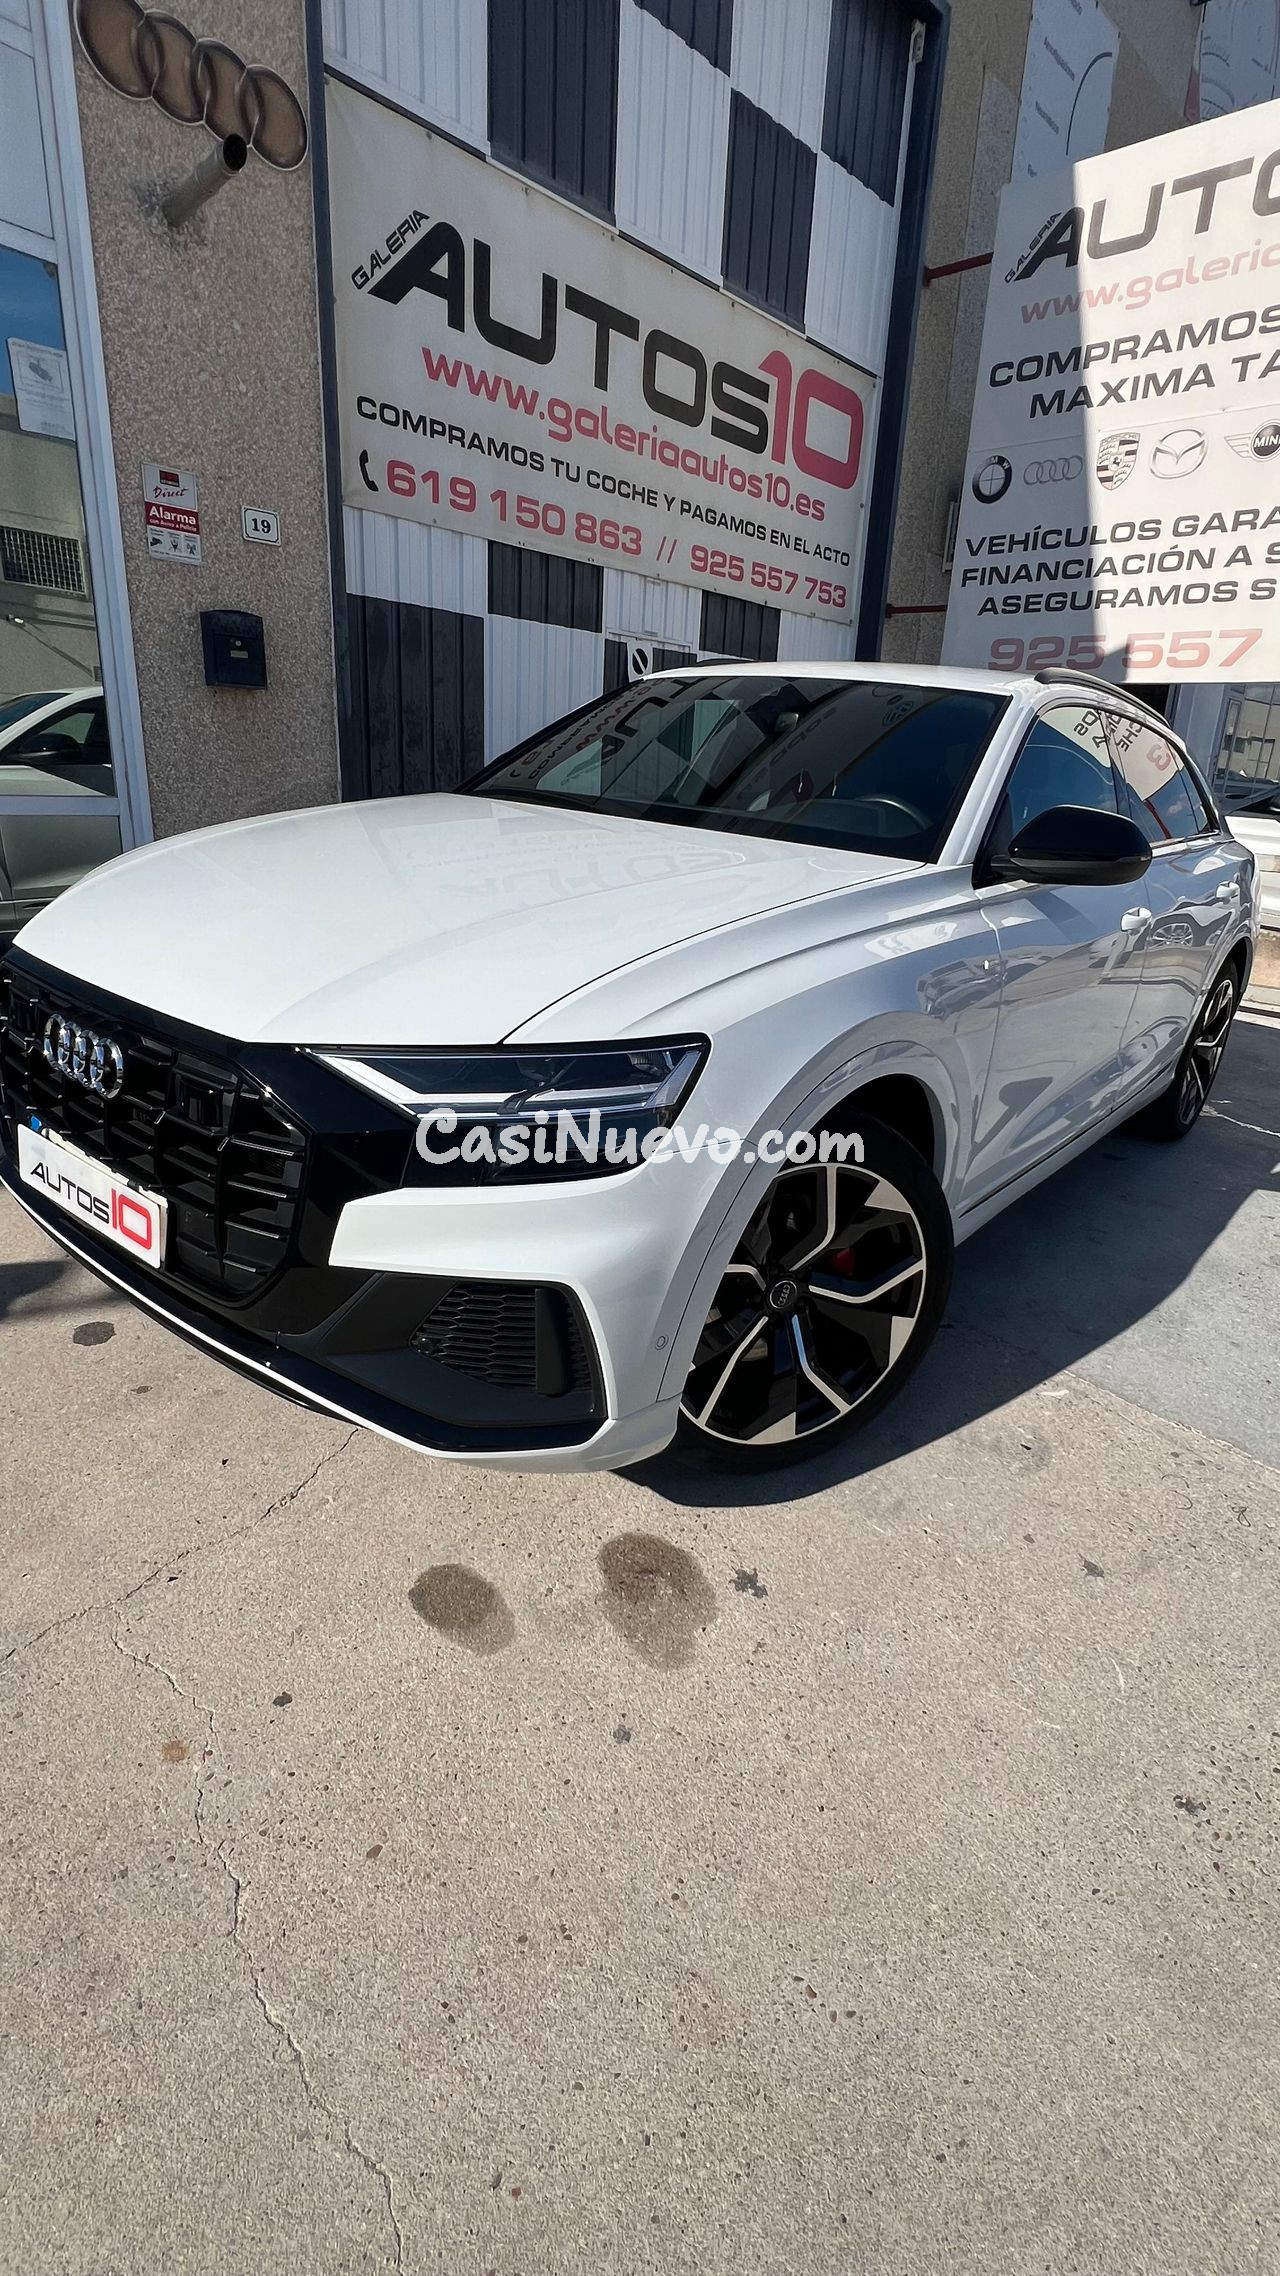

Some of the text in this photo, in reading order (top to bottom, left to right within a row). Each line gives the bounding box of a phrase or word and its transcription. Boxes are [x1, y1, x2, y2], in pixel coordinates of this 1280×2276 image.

[351, 209, 430, 290] GALERIA
[1004, 212, 1062, 283] GALERIA
[367, 221, 864, 490] AUTOS10
[1029, 363, 1216, 418] MAXIMA
[421, 346, 826, 521] www.galeriaautos10.es
[152, 485, 189, 499] Direct
[356, 395, 850, 567] COMPRAMOS TU COCHE Y PAGAMOS EN EL ACTO
[149, 506, 196, 525] Alarma
[251, 517, 271, 534] 19
[386, 459, 477, 513] 619
[489, 489, 566, 536] 150
[574, 511, 642, 556] 863
[690, 544, 745, 583] 925
[750, 561, 799, 595] 557
[804, 576, 847, 608] 753
[965, 519, 1162, 557] VEHÍCULOS
[961, 545, 1216, 588] FINANCIACIÓN
[1223, 545, 1253, 568] A
[977, 580, 1239, 617] ASEGURAMOS
[987, 628, 1263, 671] 925 557
[30, 1161, 153, 1250] AUTOS10
